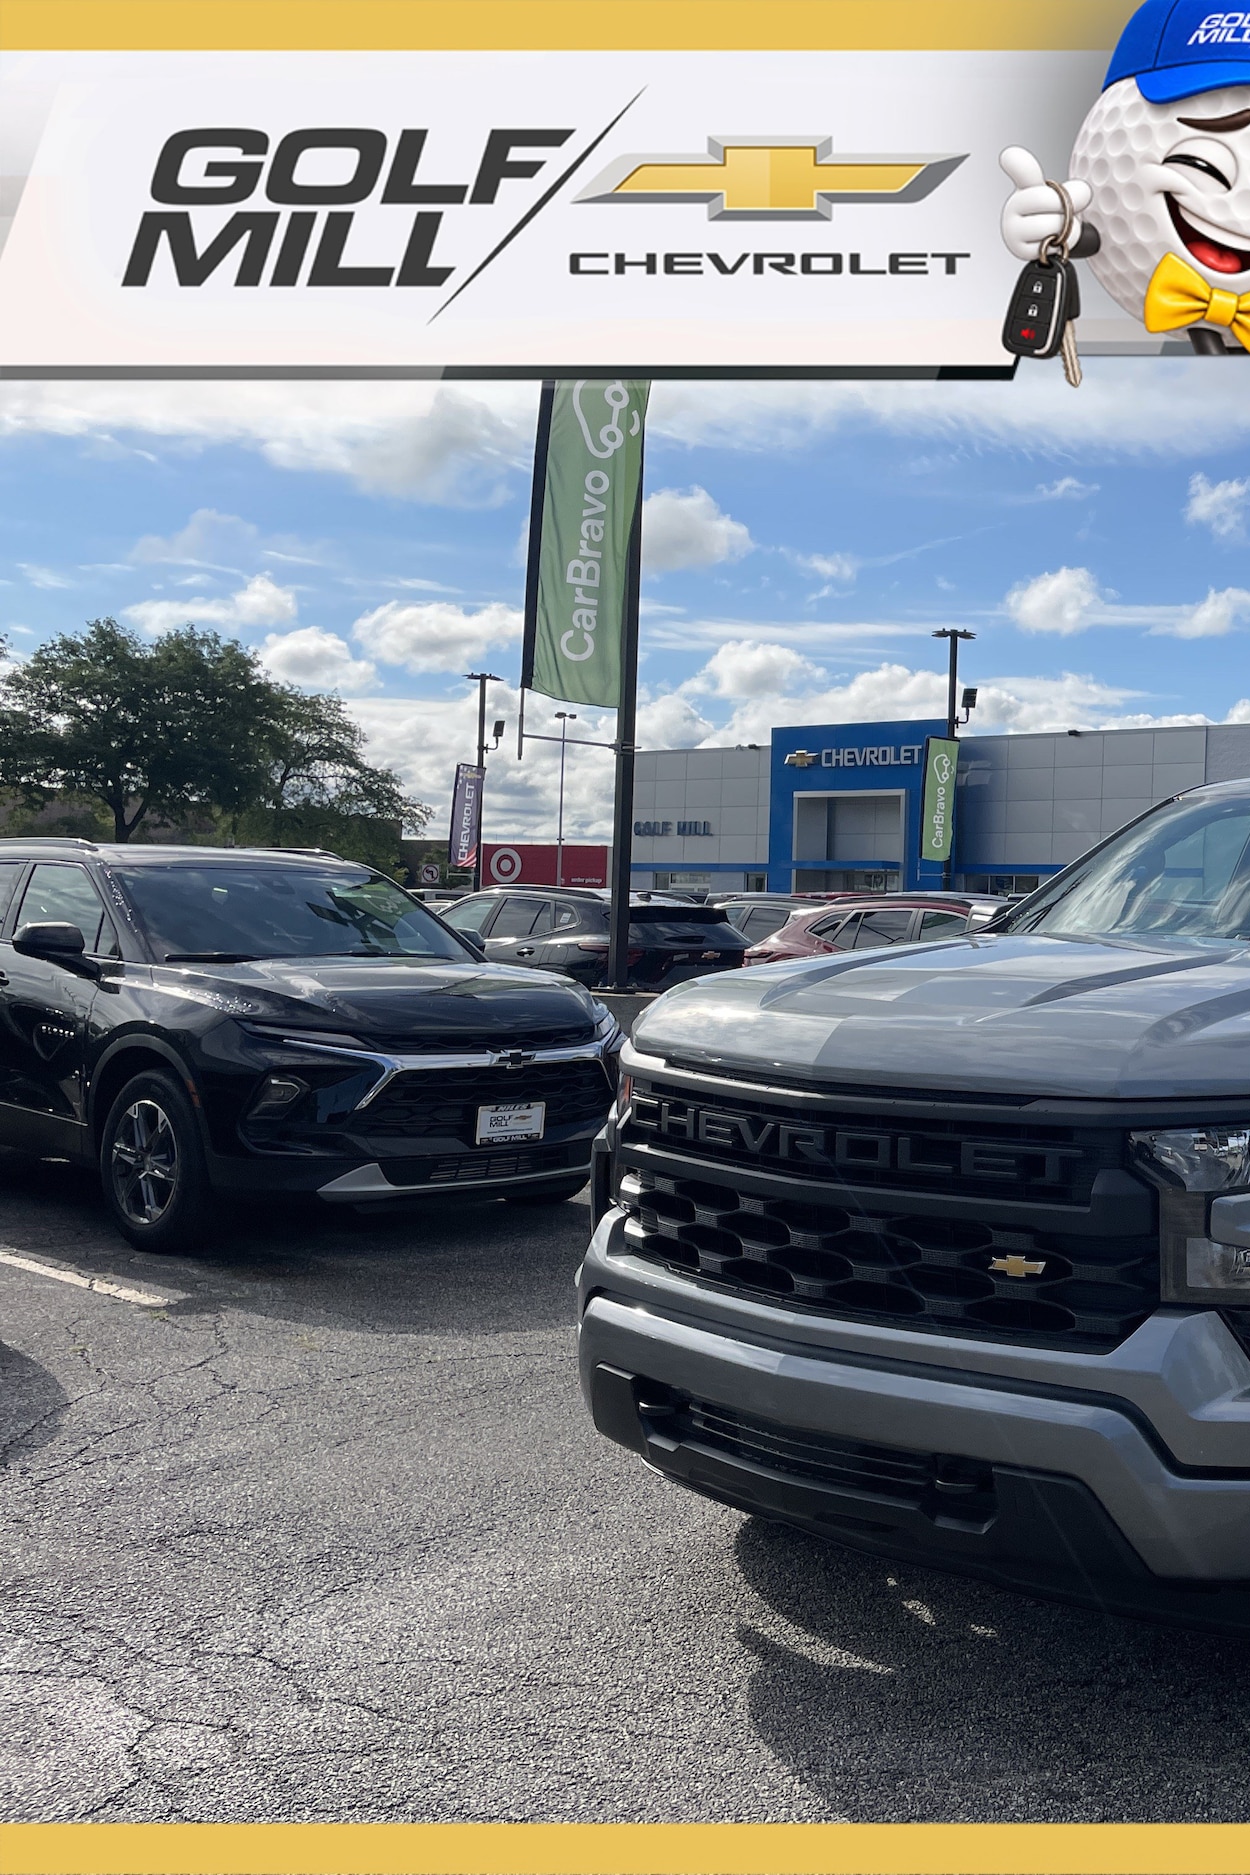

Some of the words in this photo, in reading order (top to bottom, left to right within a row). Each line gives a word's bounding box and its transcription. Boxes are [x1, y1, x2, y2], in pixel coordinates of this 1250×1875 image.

[560, 470, 610, 662] CarBravo
[821, 745, 922, 768] CHEVROLET
[458, 782, 475, 861] CHEVROLET
[634, 821, 673, 836] GOLF
[677, 821, 713, 836] MILL
[931, 786, 945, 848] CarBravo
[630, 1095, 1084, 1183] CHEVROLET
